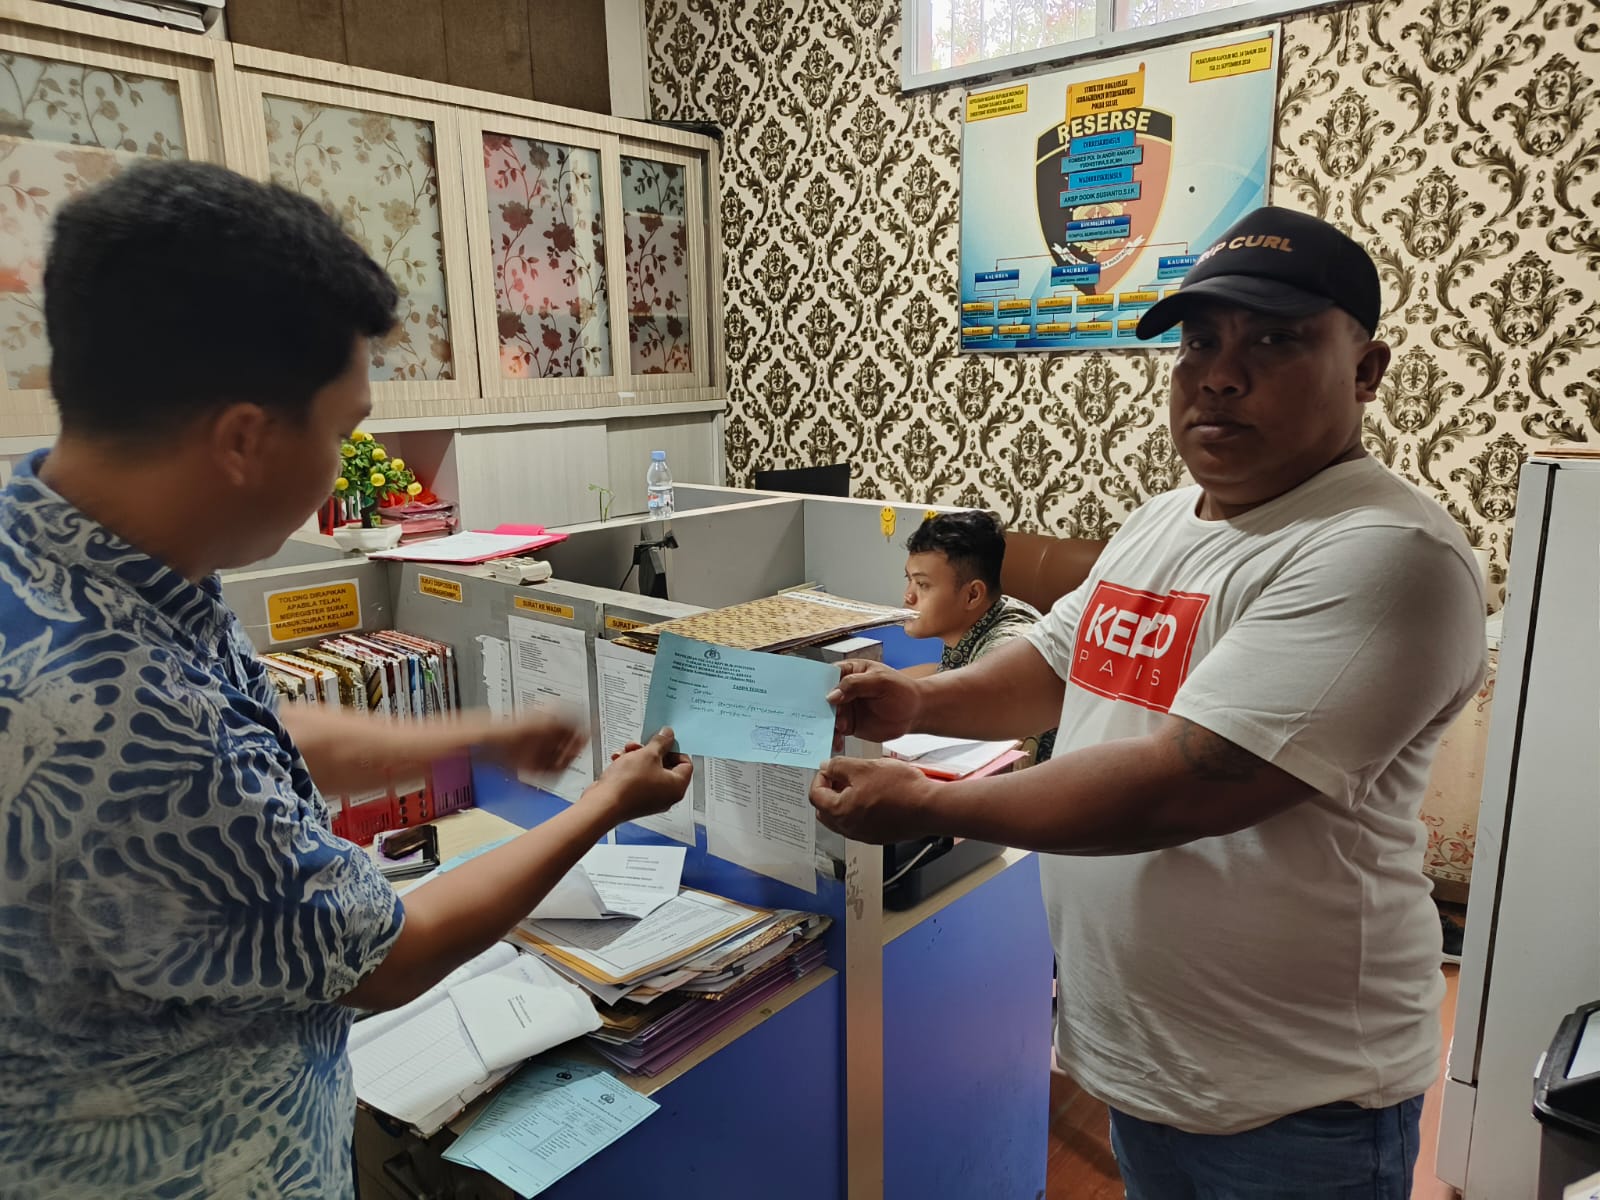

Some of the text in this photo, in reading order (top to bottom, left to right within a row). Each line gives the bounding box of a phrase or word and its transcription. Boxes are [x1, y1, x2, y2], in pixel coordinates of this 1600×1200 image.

[1057, 110, 1152, 144] RESERSE
[1228, 234, 1293, 253] CURL
[279, 588, 346, 604] TOLONG DIRAPIKAN
[286, 597, 341, 611] APABILA TELAH
[326, 603, 349, 613] SURAT
[522, 600, 538, 609] SURAT
[327, 610, 354, 621] KELUAR
